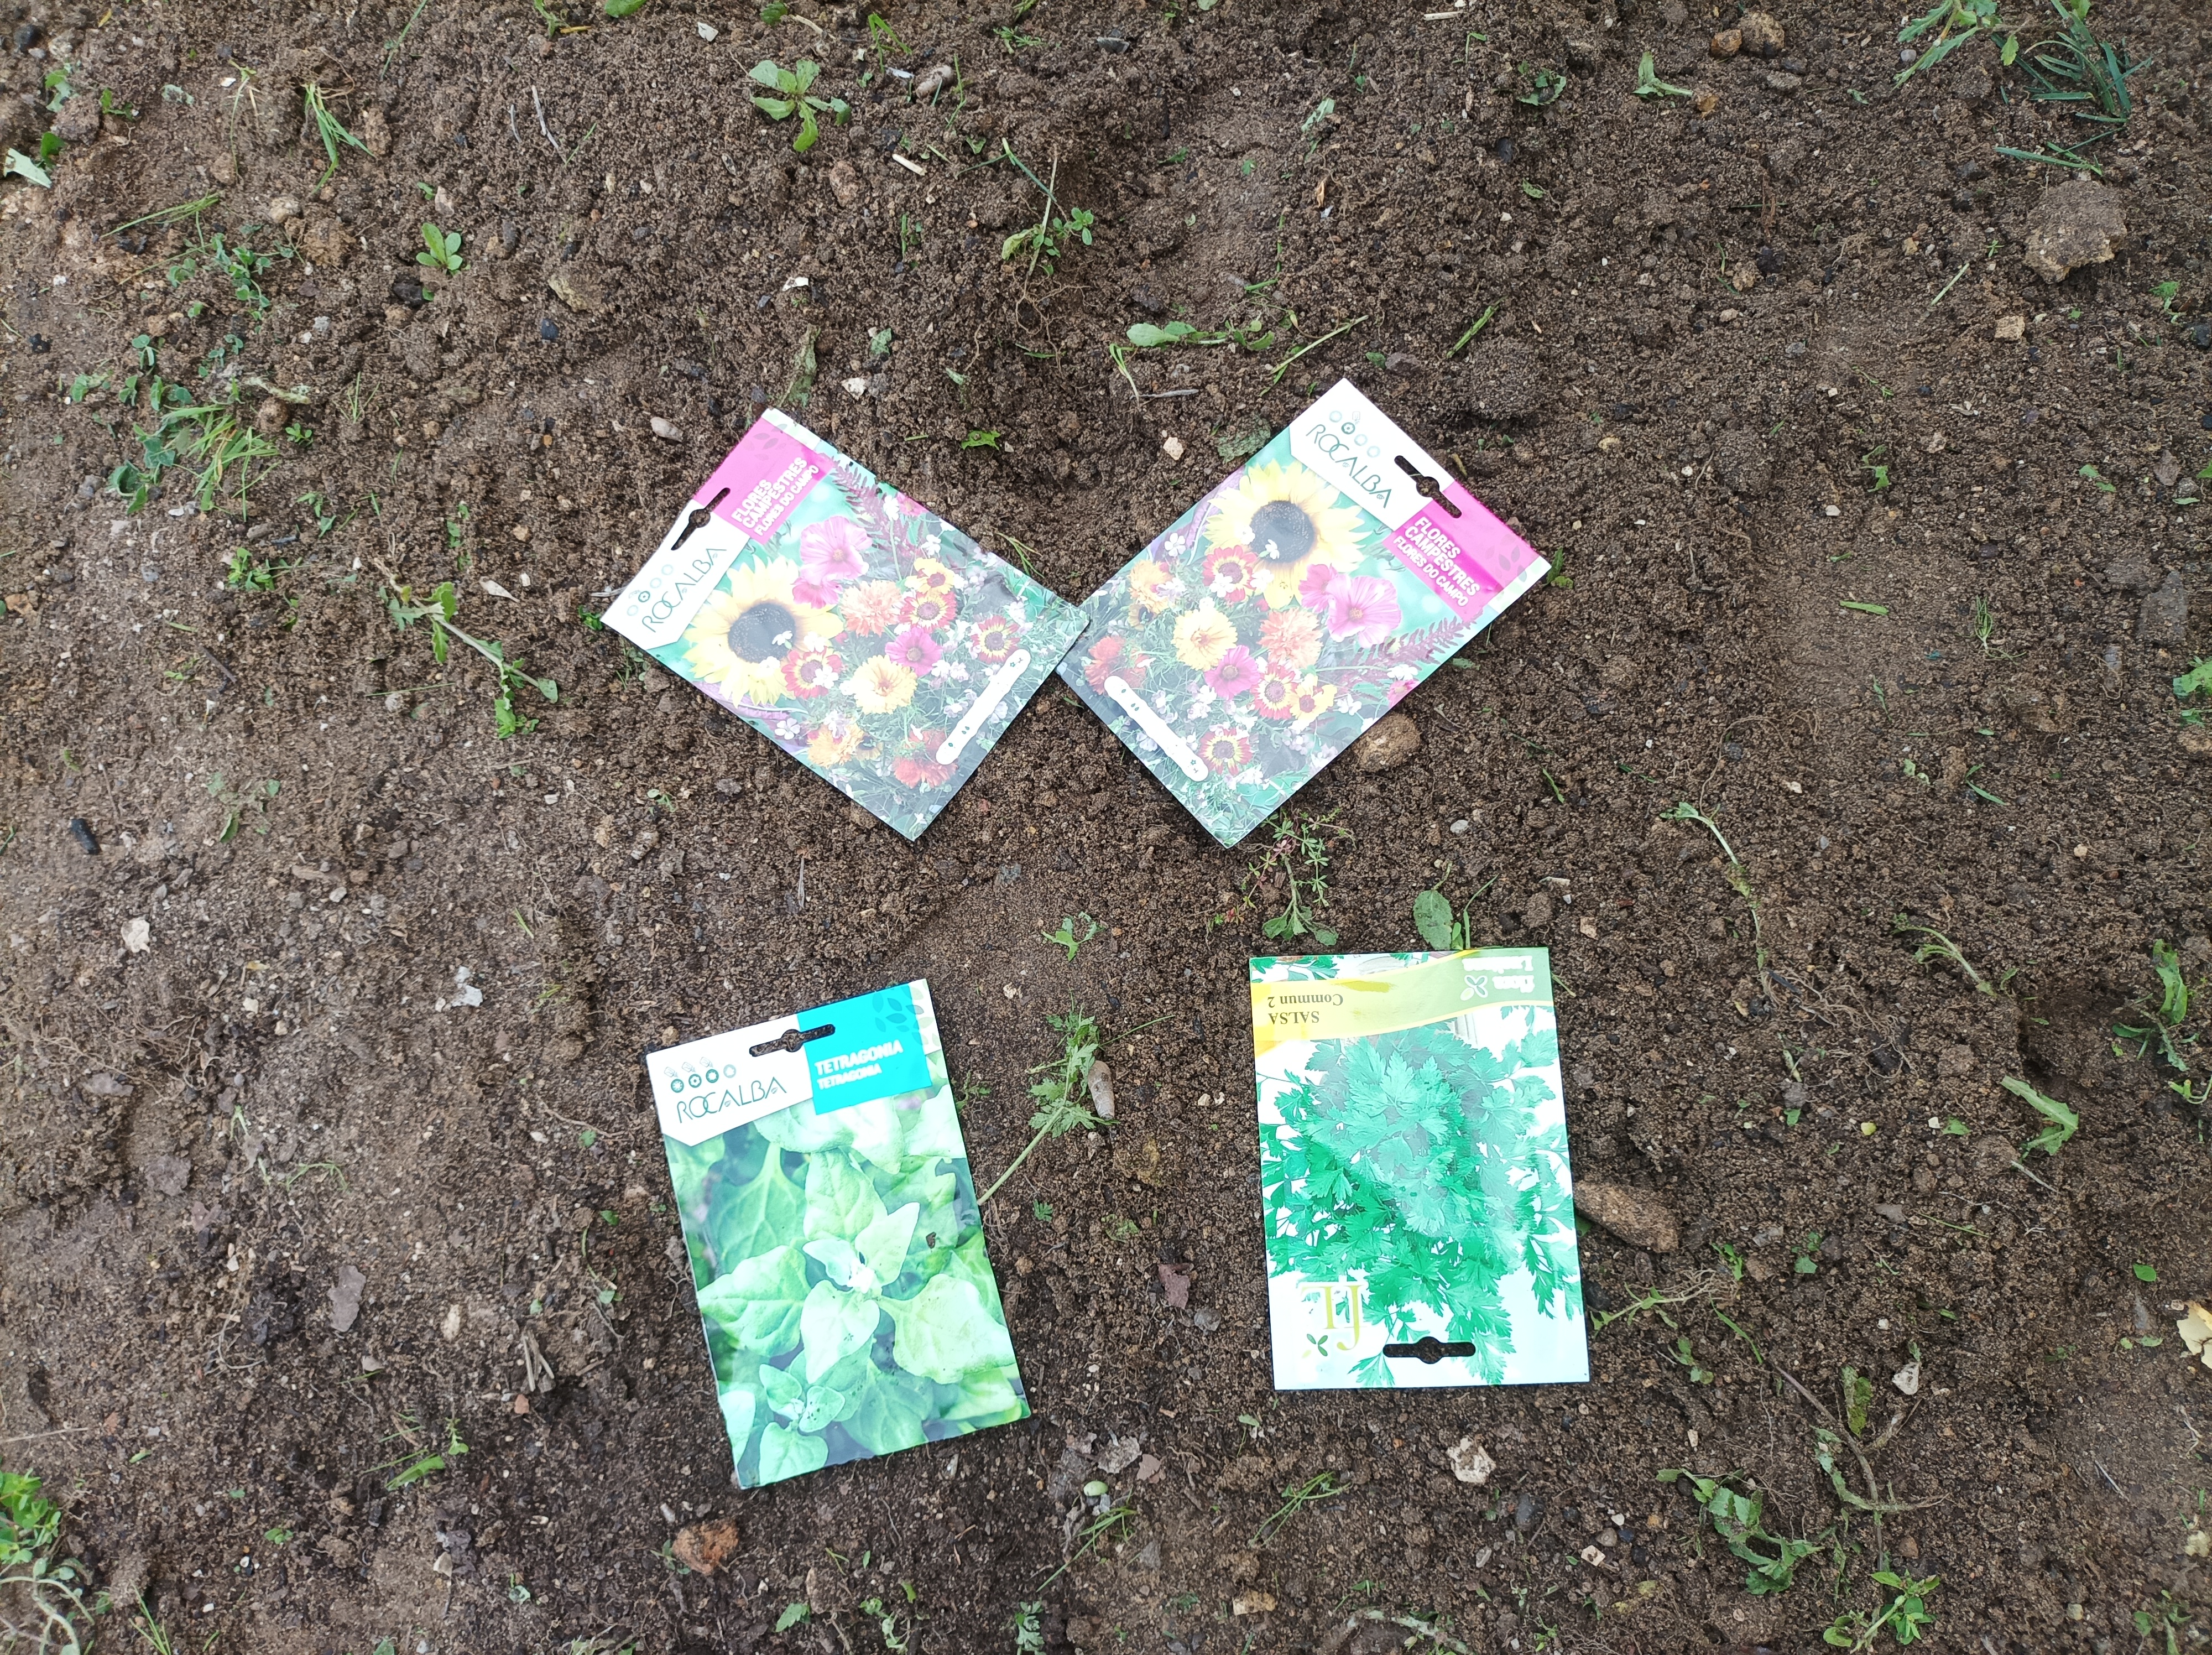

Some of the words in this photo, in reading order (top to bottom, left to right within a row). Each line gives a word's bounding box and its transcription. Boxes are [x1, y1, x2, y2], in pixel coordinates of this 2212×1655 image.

[1306, 424, 1392, 508] ROCALBA
[731, 479, 772, 522] FLORES
[742, 457, 807, 528] CAMPESTRES
[754, 504, 785, 536] FLORES
[779, 492, 795, 507] DO
[790, 465, 819, 494] CAMPO
[1415, 516, 1461, 559] FLORES
[1393, 535, 1427, 568] FLORES
[1422, 563, 1439, 579] DO
[1436, 575, 1468, 606] CAMPO
[1405, 526, 1480, 596] CAMPESTRES
[642, 548, 727, 632] ROCALBA
[1267, 996, 1275, 1008] 2
[1268, 1011, 1319, 1024] SALSA
[1280, 994, 1343, 1006] Commun
[814, 1039, 904, 1075] TETRAGONIA
[817, 1063, 882, 1090] TETRAGONIA
[676, 1076, 787, 1123] ROCALBA
